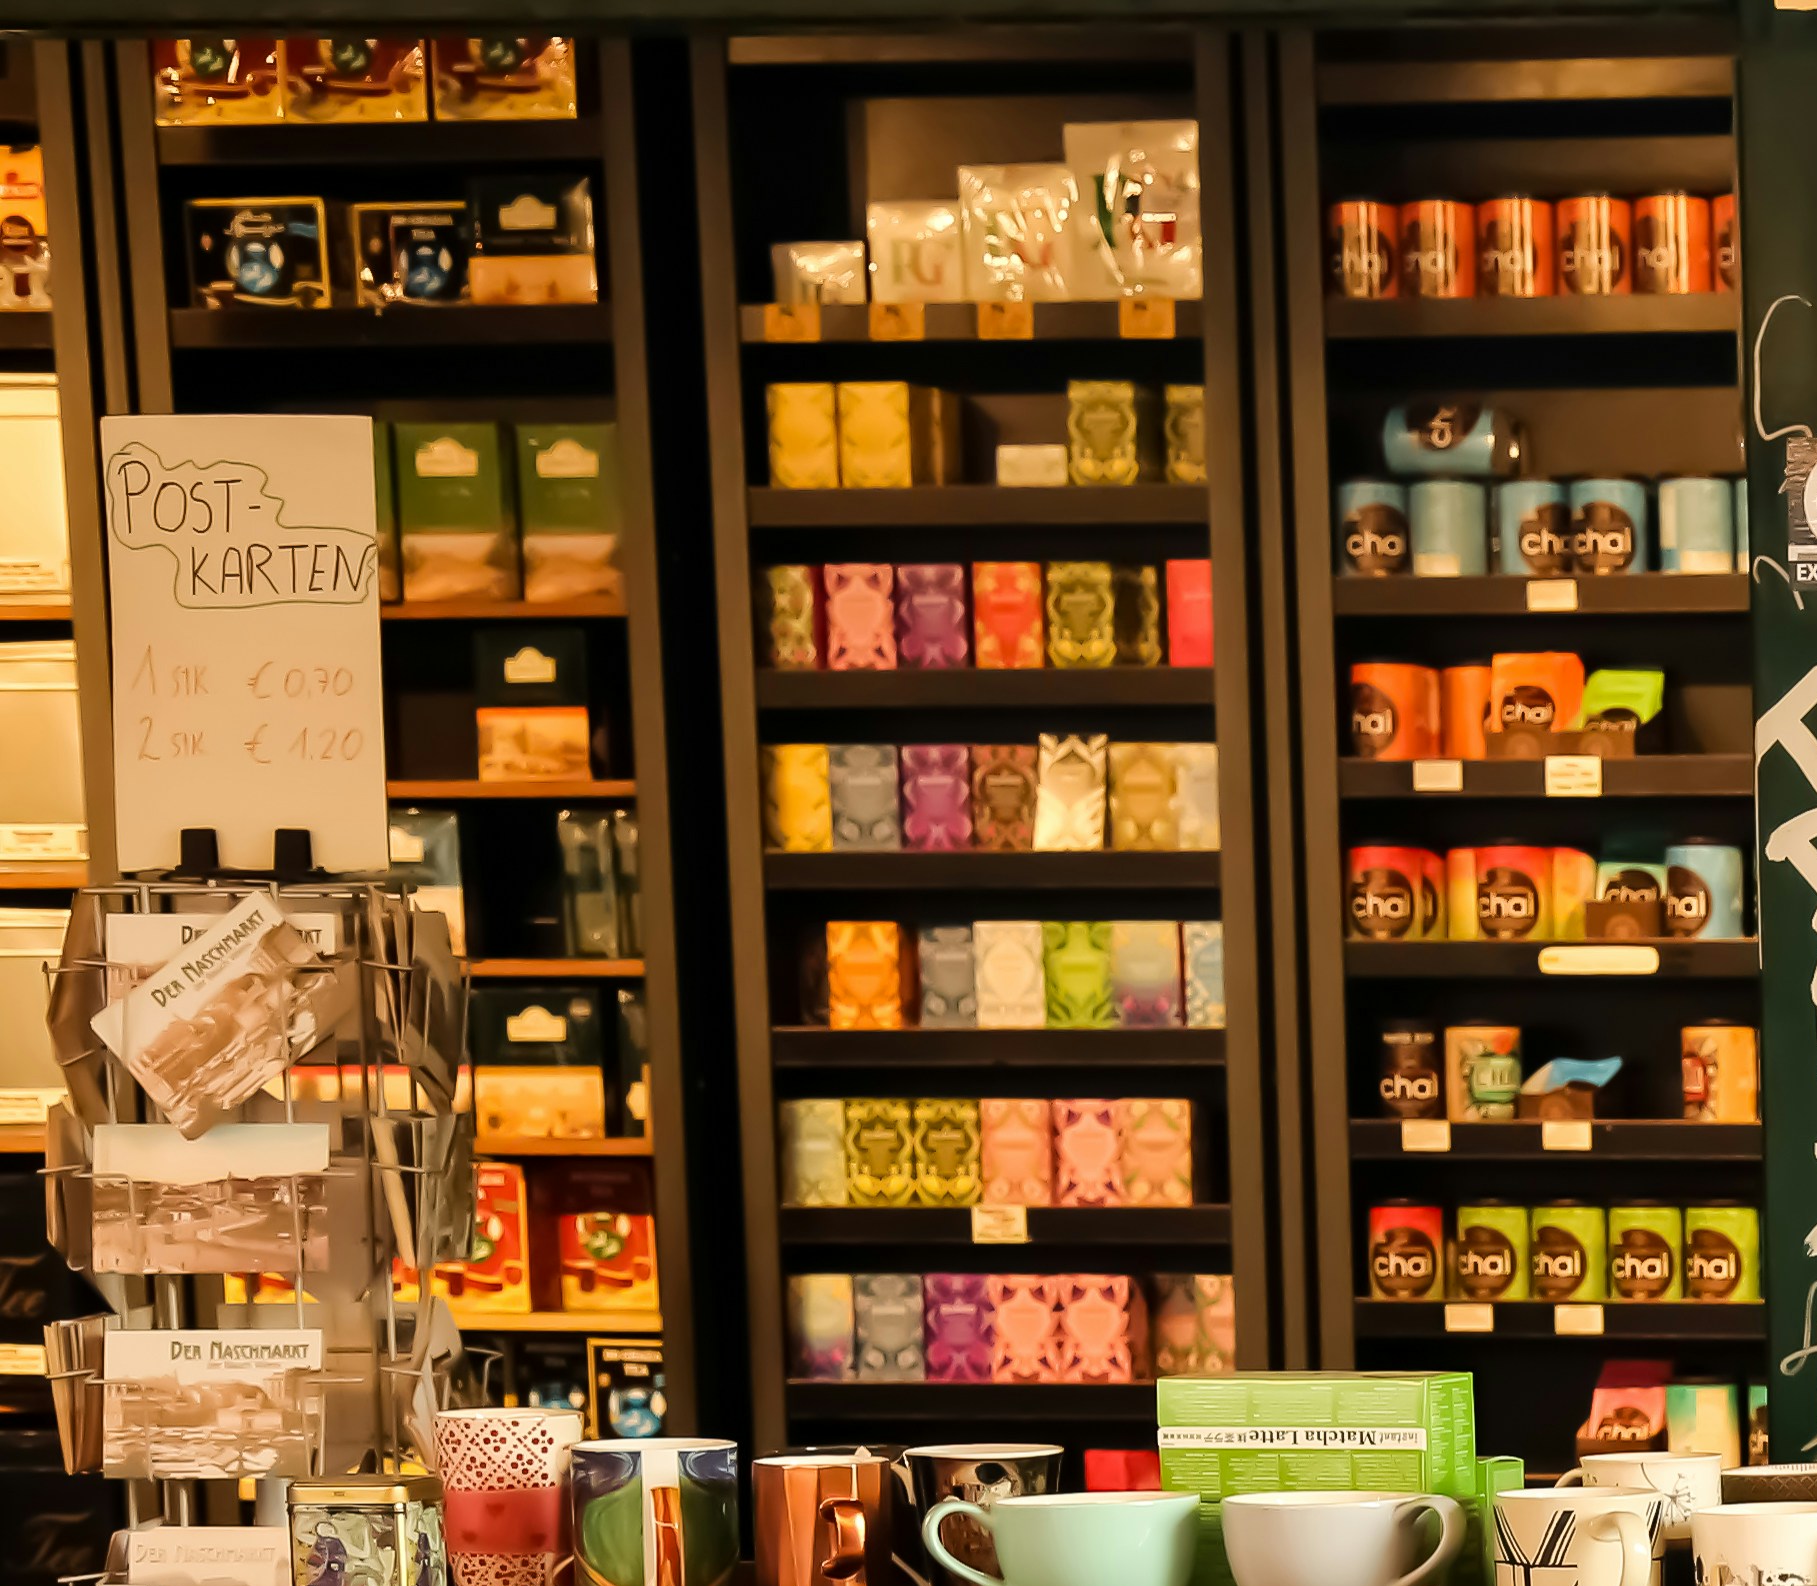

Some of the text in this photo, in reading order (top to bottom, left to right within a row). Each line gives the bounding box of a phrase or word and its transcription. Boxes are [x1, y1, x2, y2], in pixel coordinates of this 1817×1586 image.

[191, 543, 377, 596] KARTEN
[210, 1340, 310, 1361] NASCHMARKT
[1248, 1429, 1299, 1446] Latte
[1304, 1429, 1376, 1447] Matcha
